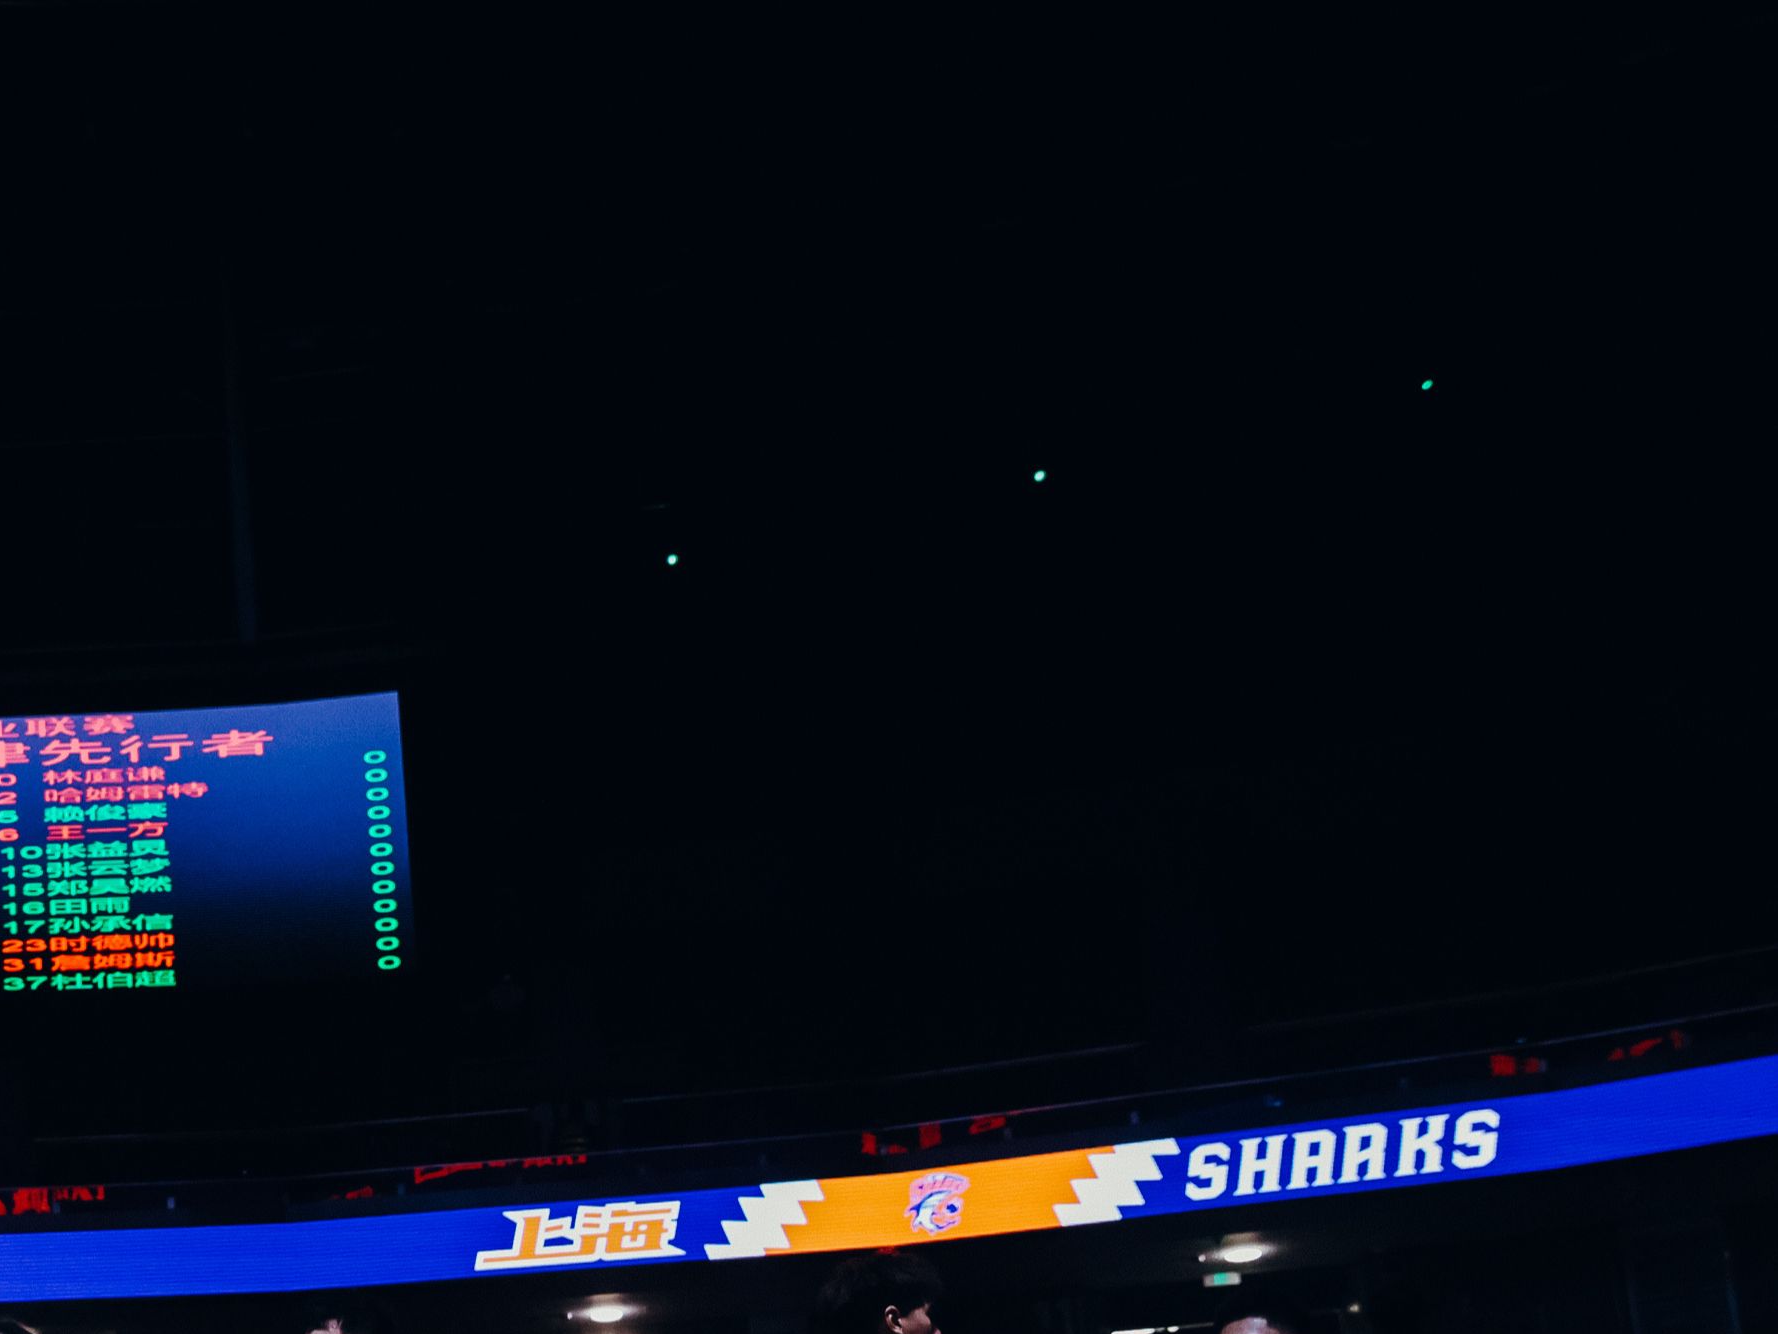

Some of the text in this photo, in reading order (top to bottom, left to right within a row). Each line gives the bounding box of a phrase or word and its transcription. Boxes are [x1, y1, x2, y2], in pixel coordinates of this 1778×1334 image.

[364, 750, 386, 764] 0
[365, 768, 388, 783] 0
[366, 787, 389, 801] 0
[367, 805, 390, 820] 0
[47, 821, 168, 841] 王一方
[369, 824, 391, 839] 0
[1, 845, 43, 860] 10
[370, 843, 393, 857] 0
[1, 864, 43, 879] 13
[371, 862, 393, 876] 0
[2, 883, 44, 898] 15
[372, 880, 395, 894] 0
[3, 896, 130, 917] 16 田雨
[374, 899, 397, 913] 0
[3, 913, 173, 935] 17 孙承信
[375, 917, 398, 932] 0
[2, 932, 175, 953] 23 时德帅
[376, 936, 399, 951] 0
[3, 956, 43, 972] 31
[378, 955, 400, 970] 0
[3, 975, 47, 991] 37
[1184, 1108, 1501, 1202] SHARKS
[474, 1200, 687, 1273] 上海
